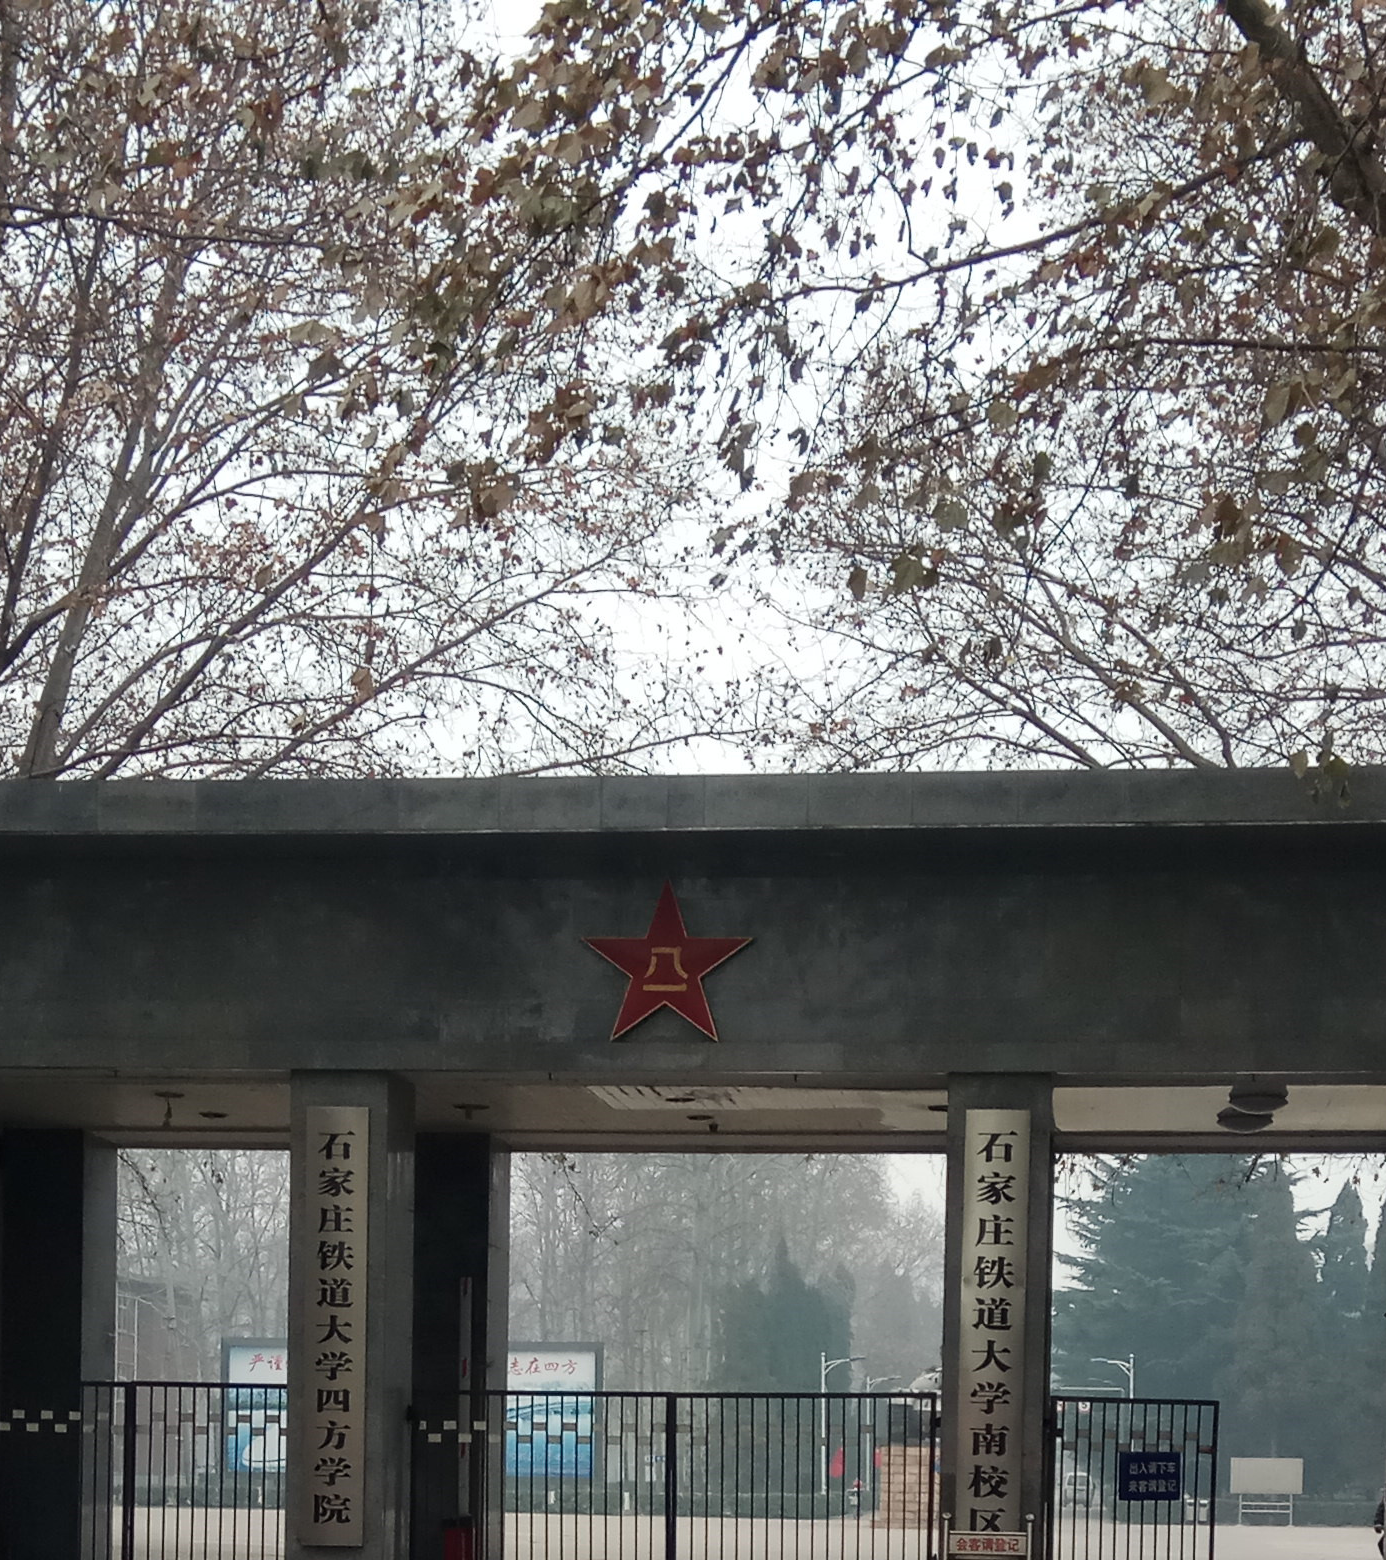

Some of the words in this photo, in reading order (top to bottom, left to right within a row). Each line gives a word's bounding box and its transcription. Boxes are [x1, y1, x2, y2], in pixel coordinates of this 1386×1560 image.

[248, 1352, 288, 1373] 严谨
[312, 1129, 357, 1525] 石家庄铁道大学四方学院
[967, 1129, 1018, 1532] 石家庄铁道大学南校区
